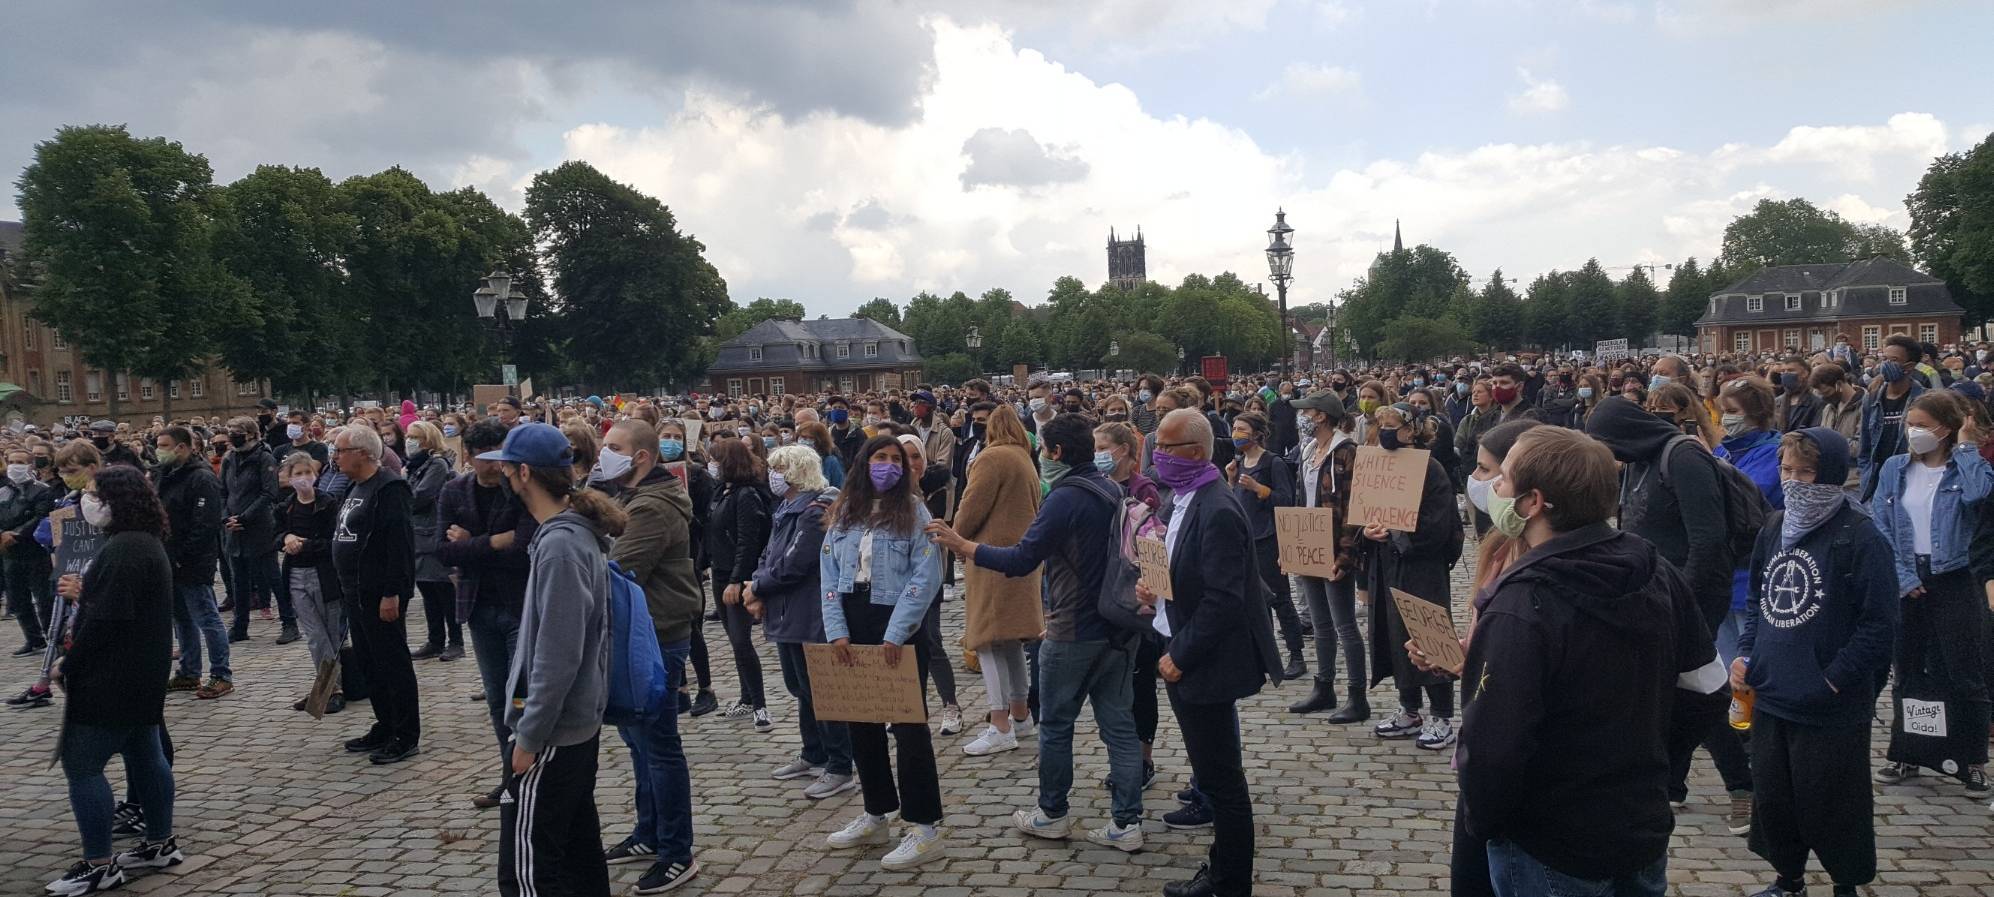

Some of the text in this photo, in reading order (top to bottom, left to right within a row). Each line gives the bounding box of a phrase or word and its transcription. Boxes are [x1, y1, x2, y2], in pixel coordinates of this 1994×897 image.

[64, 415, 90, 425] BLACK
[1354, 455, 1397, 472] WHITE
[1352, 472, 1407, 491] SILENCE
[1351, 491, 1364, 505] IS
[1278, 512, 1328, 538] NO JUSTICE
[1363, 506, 1418, 528] VIOLENCE
[1281, 545, 1326, 566] NO PEACE
[1763, 548, 1822, 585] ANIMAL LIBERATION
[1396, 597, 1459, 641] GEORGE
[1760, 597, 1821, 628] HUMAN LIBERATION
[1408, 626, 1461, 666] FLOYD
[1906, 704, 1941, 719] Vintage
[1911, 721, 1938, 733] Oida!
